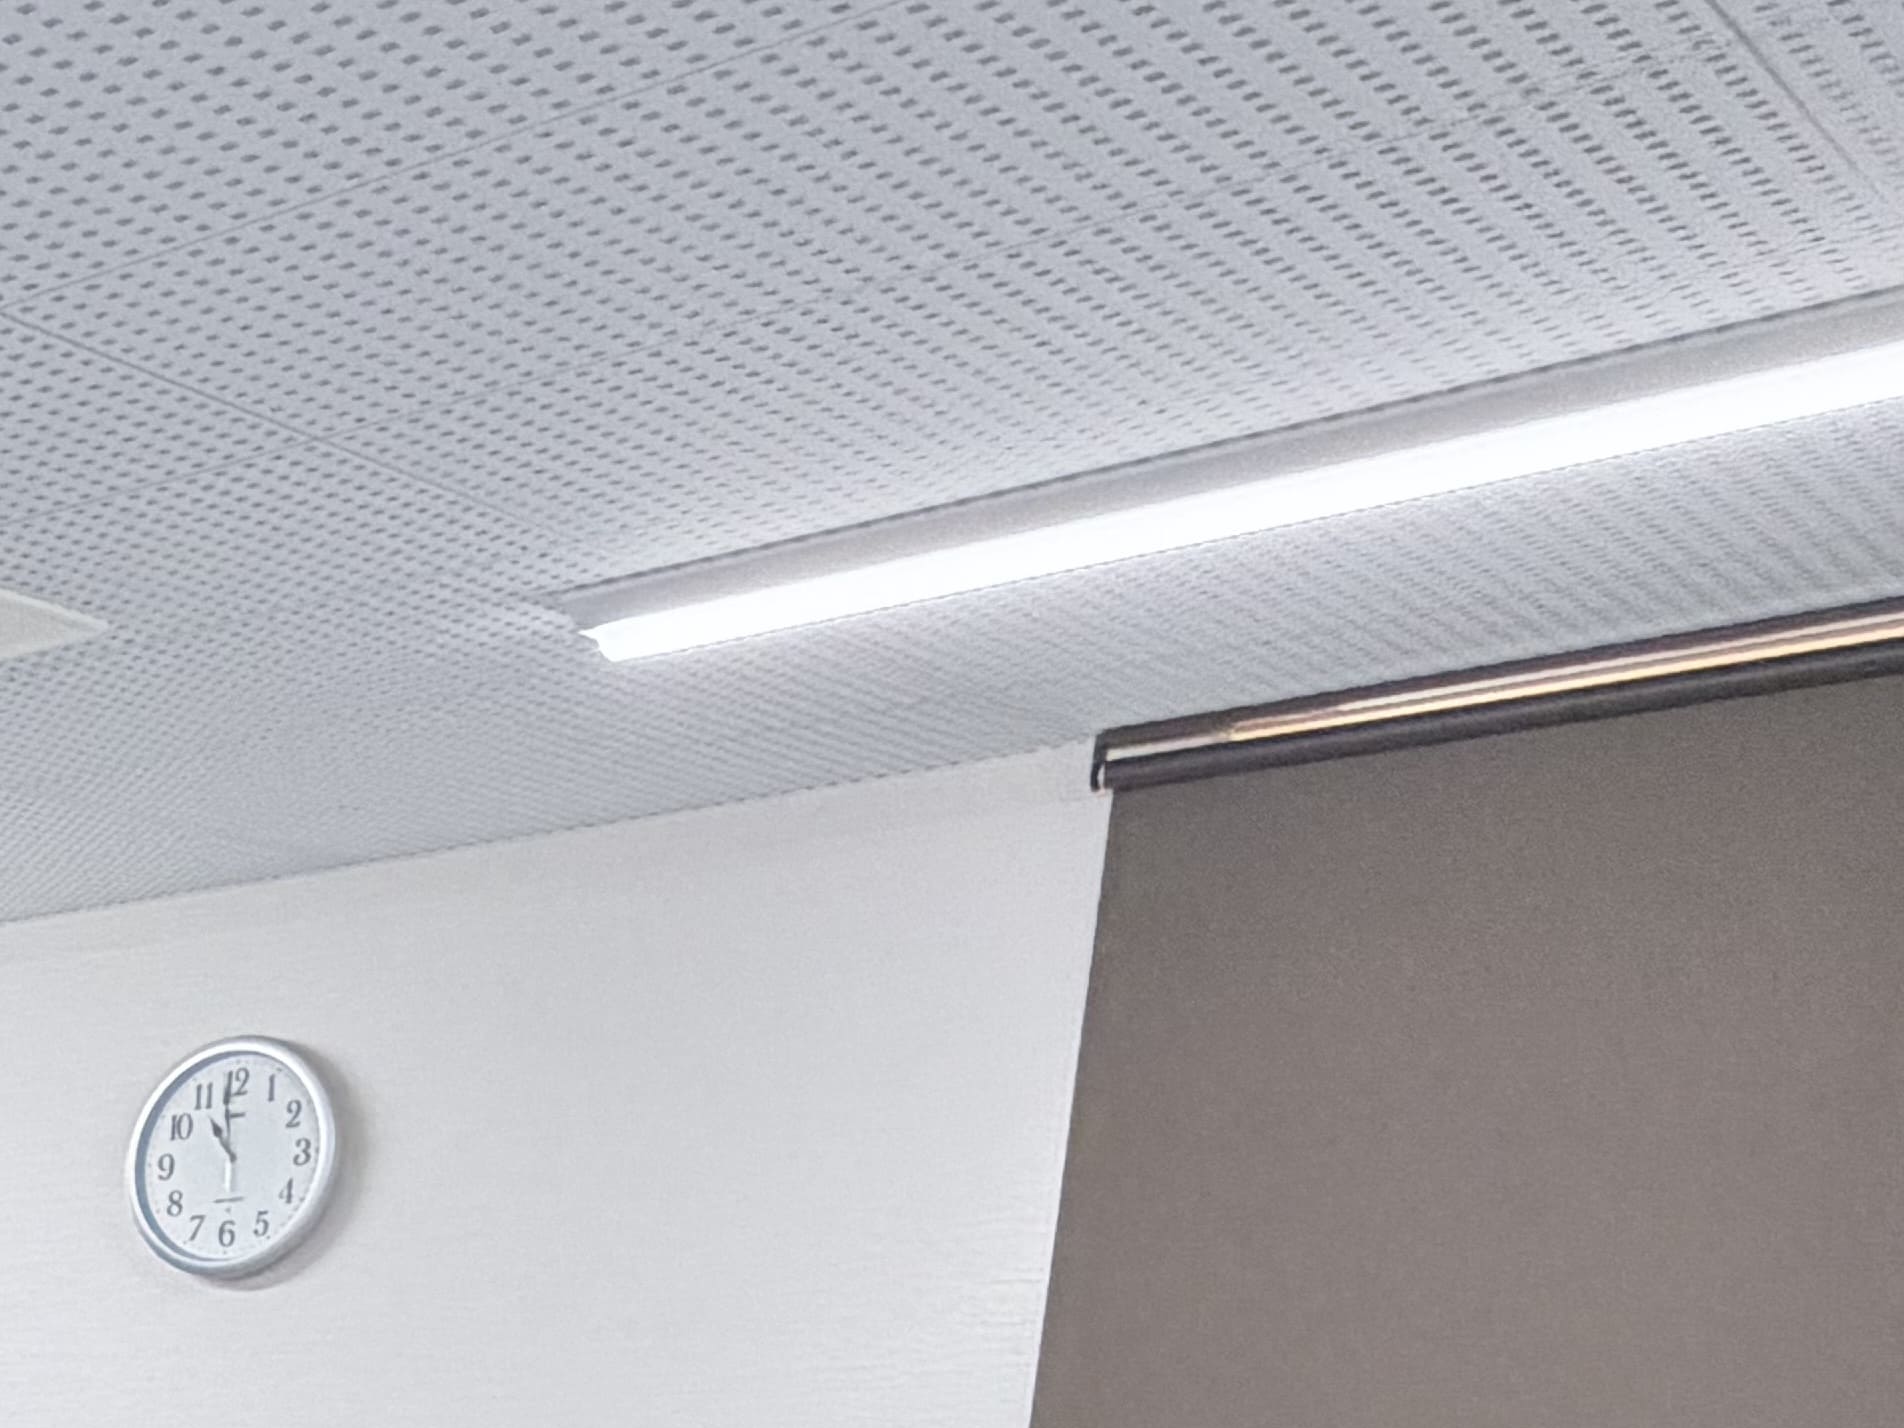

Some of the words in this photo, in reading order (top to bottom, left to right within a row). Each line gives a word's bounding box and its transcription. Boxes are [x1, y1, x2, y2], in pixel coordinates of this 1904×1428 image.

[224, 1067, 249, 1097] 12
[268, 1074, 276, 1102] 1
[195, 1082, 214, 1110] 11
[170, 1113, 193, 1141] 10
[286, 1100, 302, 1128] 2
[293, 1138, 311, 1166] 3
[158, 1154, 175, 1181] 9
[167, 1190, 183, 1217] 8
[280, 1178, 294, 1204] 4
[189, 1214, 206, 1241] 7
[218, 1220, 235, 1247] 6
[253, 1211, 269, 1237] 5
